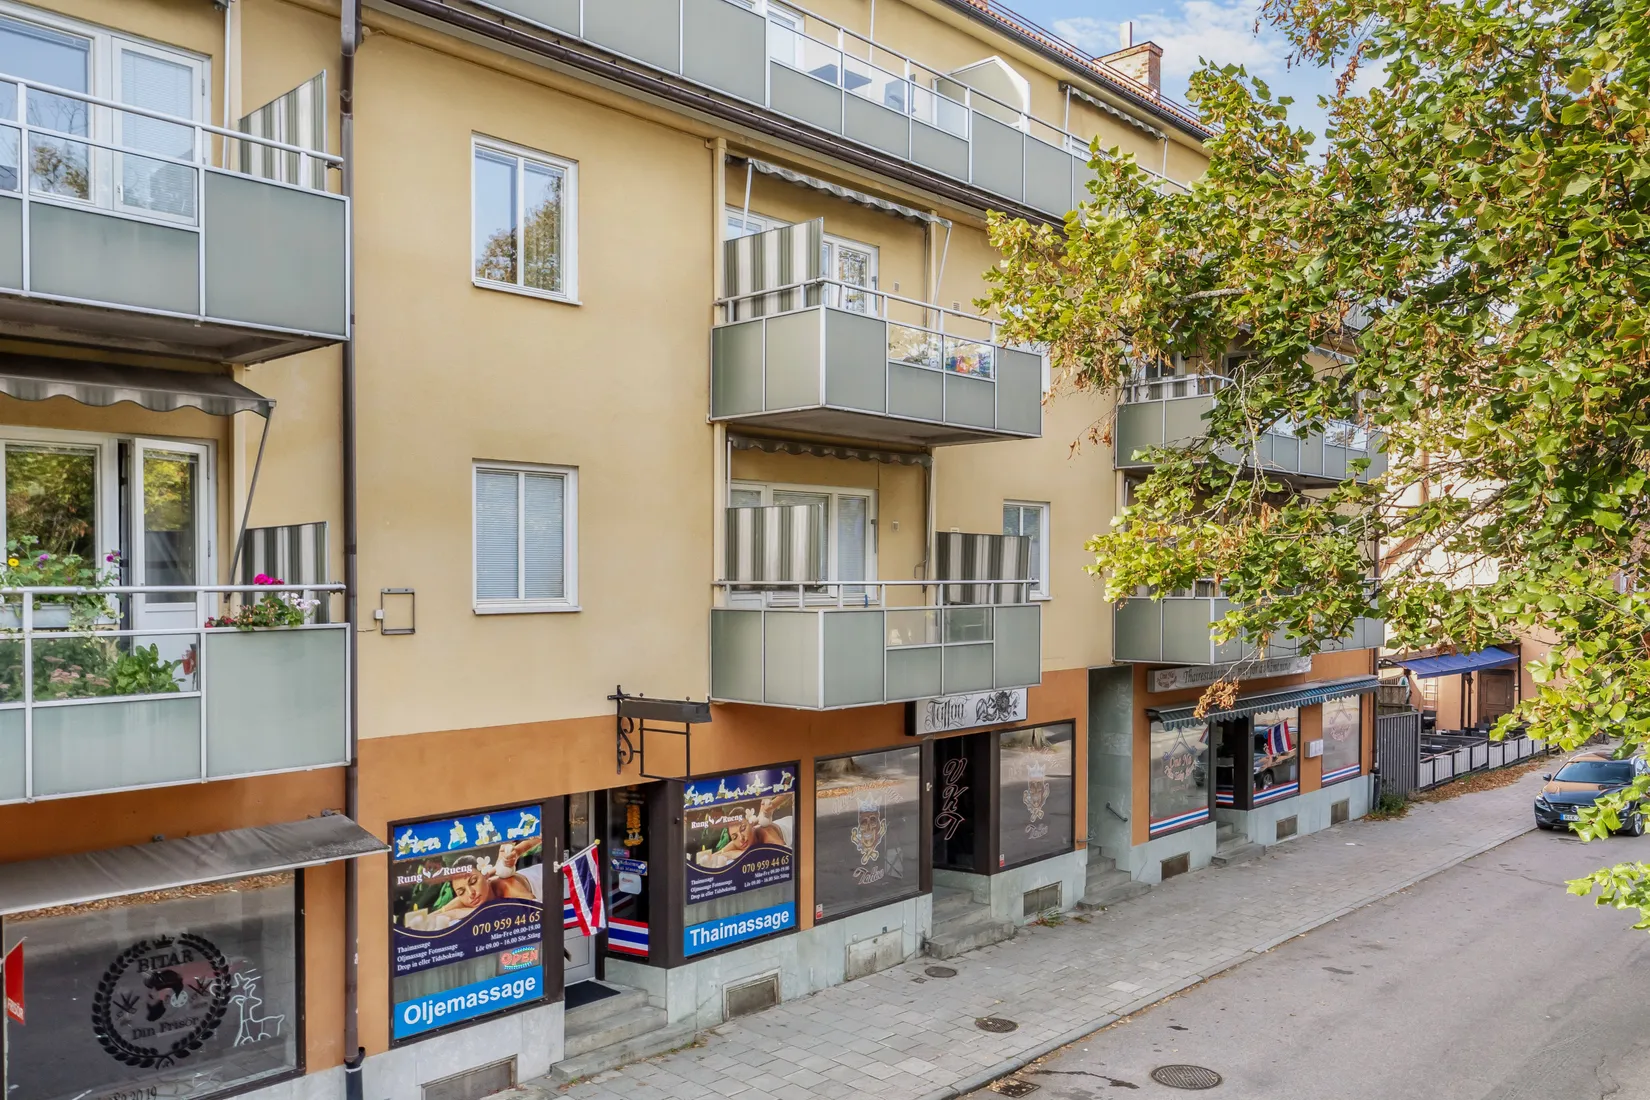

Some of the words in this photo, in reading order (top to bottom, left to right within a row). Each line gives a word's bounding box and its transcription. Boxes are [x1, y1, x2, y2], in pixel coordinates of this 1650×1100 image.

[925, 696, 970, 731] Tattoo
[397, 874, 422, 884] Rung
[444, 864, 472, 875] Rueng
[742, 864, 755, 874] 070
[757, 860, 769, 871] 959
[771, 858, 779, 867] 44
[781, 855, 789, 864] 65
[473, 922, 491, 936] 070
[494, 918, 511, 931] 959
[515, 914, 526, 925] 44
[529, 911, 540, 922] 65
[690, 910, 790, 946] Thaimassage
[397, 942, 430, 953] Thaimassage
[501, 950, 538, 965] OPEN
[136, 949, 194, 973] BITAR
[403, 976, 536, 1025] Oljemassage
[132, 1026, 156, 1040] Din
[159, 1016, 200, 1033] Frisör
